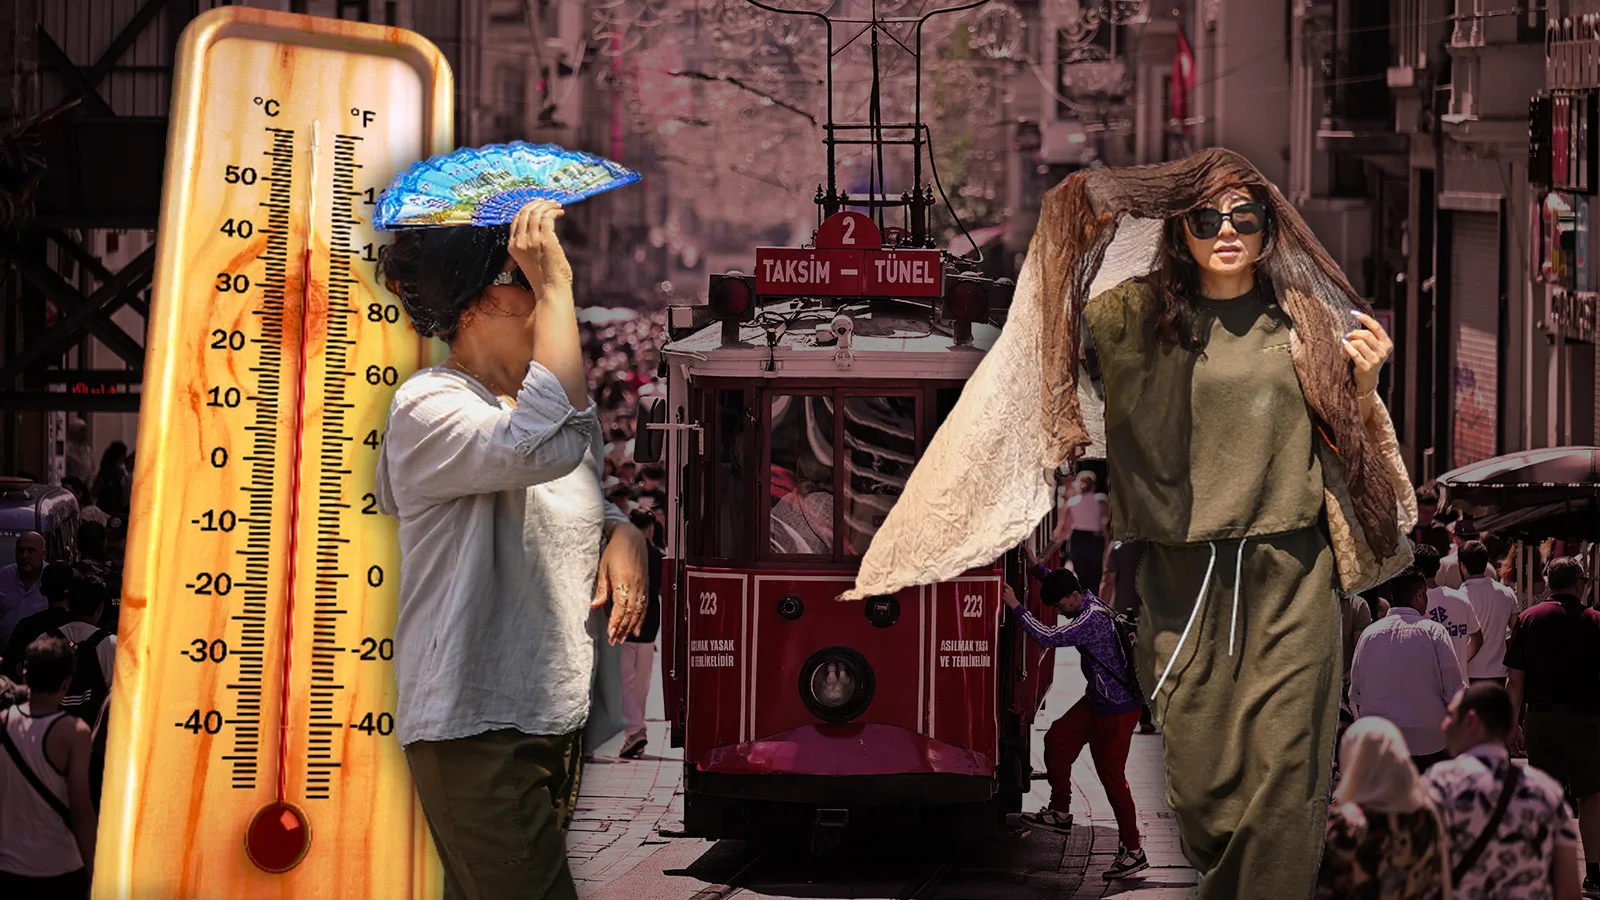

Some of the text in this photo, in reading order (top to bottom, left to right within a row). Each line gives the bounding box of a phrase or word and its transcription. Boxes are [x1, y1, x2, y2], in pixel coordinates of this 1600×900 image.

[253, 96, 280, 118] °C
[350, 107, 376, 128] °F
[224, 165, 257, 185] 50
[220, 220, 253, 239] 40
[842, 216, 856, 245] 2
[763, 254, 830, 284] TAKSİM
[874, 254, 935, 284] TÜNEL
[215, 273, 249, 293] 30
[367, 303, 399, 323] 80
[210, 330, 245, 350] 20
[366, 366, 398, 385] 60
[206, 386, 241, 407] 10
[211, 447, 229, 468] 0
[191, 510, 236, 532] -10
[185, 572, 232, 596] -20
[367, 565, 384, 588] 0
[699, 591, 718, 616] 223
[963, 594, 983, 618] 223
[180, 639, 227, 663] -30
[351, 637, 394, 661] -20
[710, 639, 735, 652] YASAK
[940, 640, 974, 652] ASILMAK
[940, 655, 950, 668] VE
[174, 710, 223, 734] -40
[349, 712, 394, 736] -40
